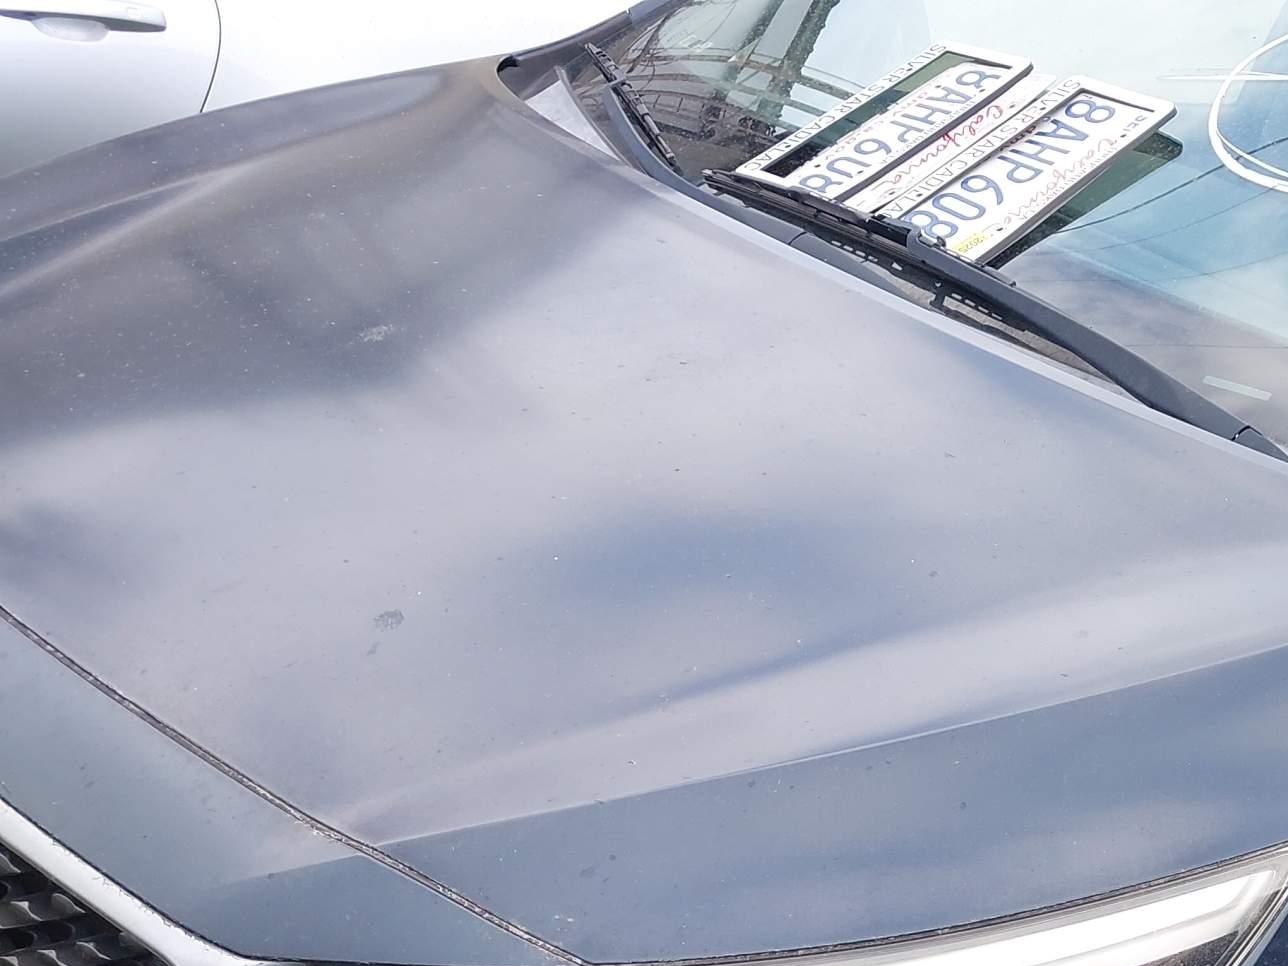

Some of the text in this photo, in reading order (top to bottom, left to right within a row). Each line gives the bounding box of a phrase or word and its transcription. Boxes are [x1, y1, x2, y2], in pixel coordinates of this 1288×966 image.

[882, 42, 947, 84] SILVER
[833, 84, 883, 117] STAR
[1011, 79, 1081, 123] SILVER
[741, 113, 835, 174] CADILLAC
[869, 102, 1004, 191] California
[961, 122, 1017, 156] STAR
[903, 95, 1118, 241] 8AHP608
